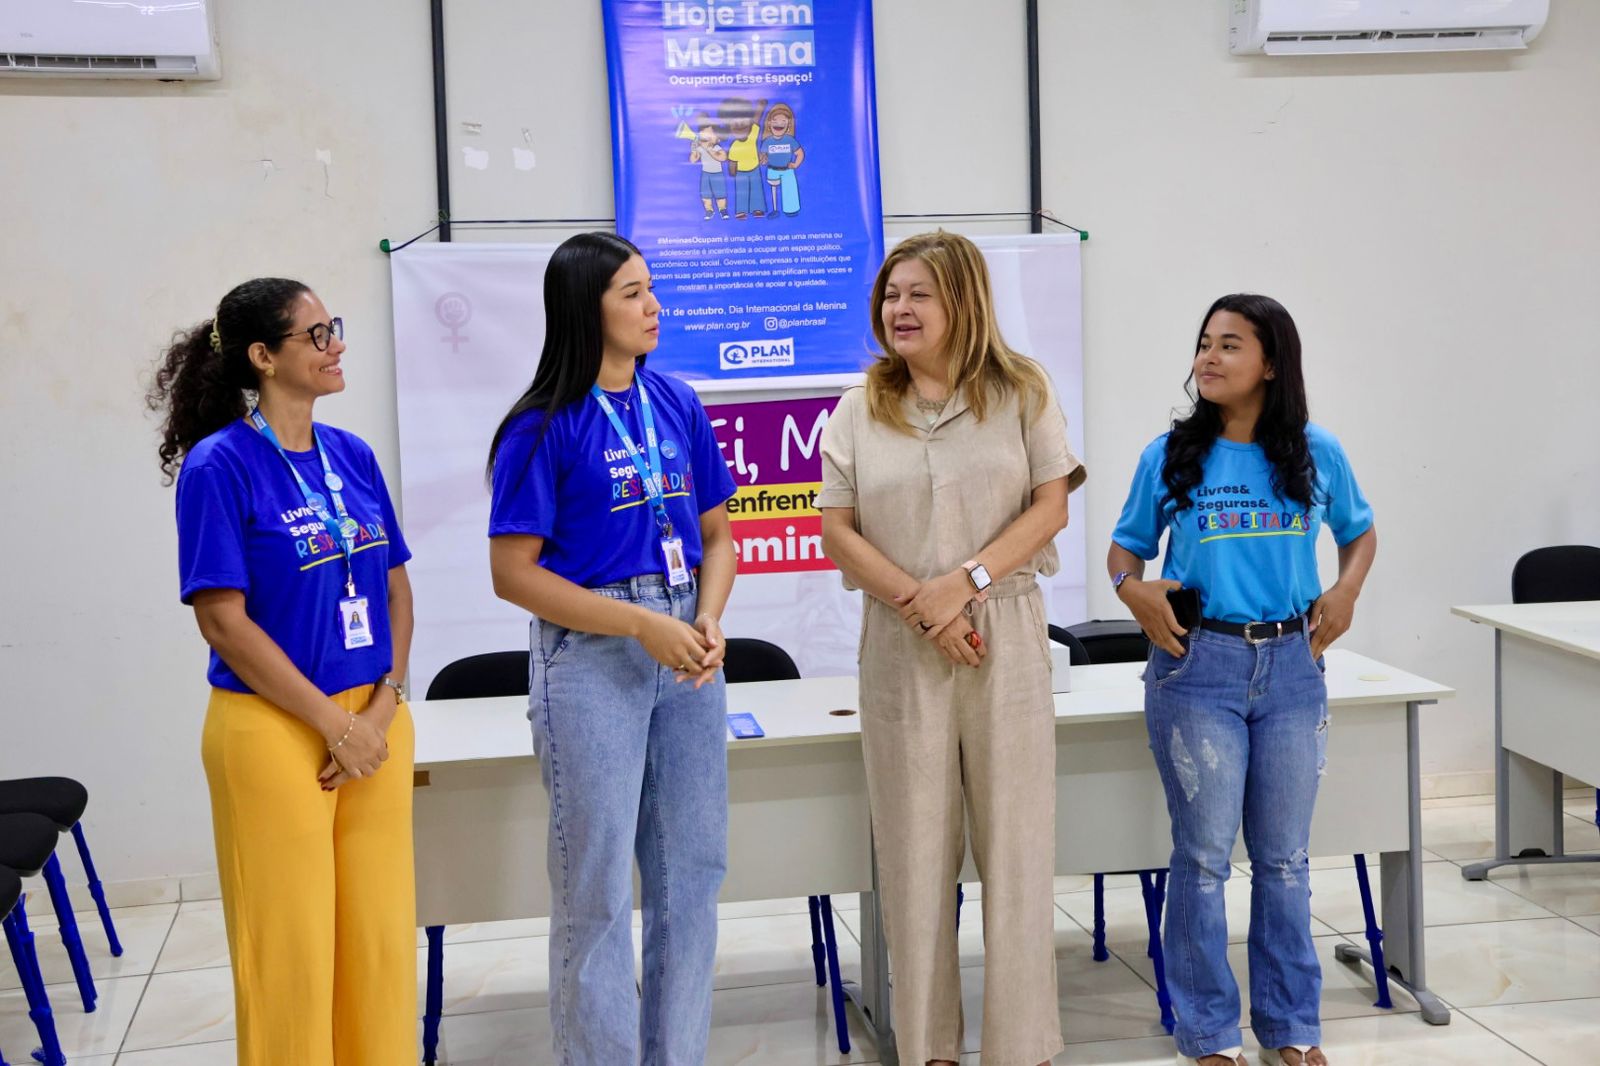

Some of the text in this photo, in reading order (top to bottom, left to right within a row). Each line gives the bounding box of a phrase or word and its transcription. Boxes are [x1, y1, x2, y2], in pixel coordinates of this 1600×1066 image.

[664, 0, 812, 34] Hoje Tem
[667, 34, 813, 67] Menina
[669, 71, 813, 87] Ocupando Esse Espaço!
[746, 234, 763, 242] ação
[708, 247, 746, 255] incentivada
[791, 244, 815, 253] espaço
[651, 260, 689, 269] econômico
[759, 257, 793, 265] empresas
[800, 255, 837, 264] instituições
[838, 255, 851, 263] que
[692, 272, 714, 280] portas
[715, 271, 731, 279] para
[742, 269, 771, 277] meninas
[772, 267, 808, 276] amplificam
[677, 283, 707, 292] mostram
[714, 281, 754, 290] importância
[765, 280, 786, 288] apoiar
[660, 301, 847, 317] 11 de outubro, Dia Internacional da Menina
[684, 321, 751, 332] www.plan.org.br
[779, 316, 827, 329] @planbrasil
[751, 344, 791, 358] PLAN
[1197, 484, 1250, 497] Livres&
[1197, 498, 1269, 512] Seguras&
[1197, 511, 1311, 532] RESPEITADAS
